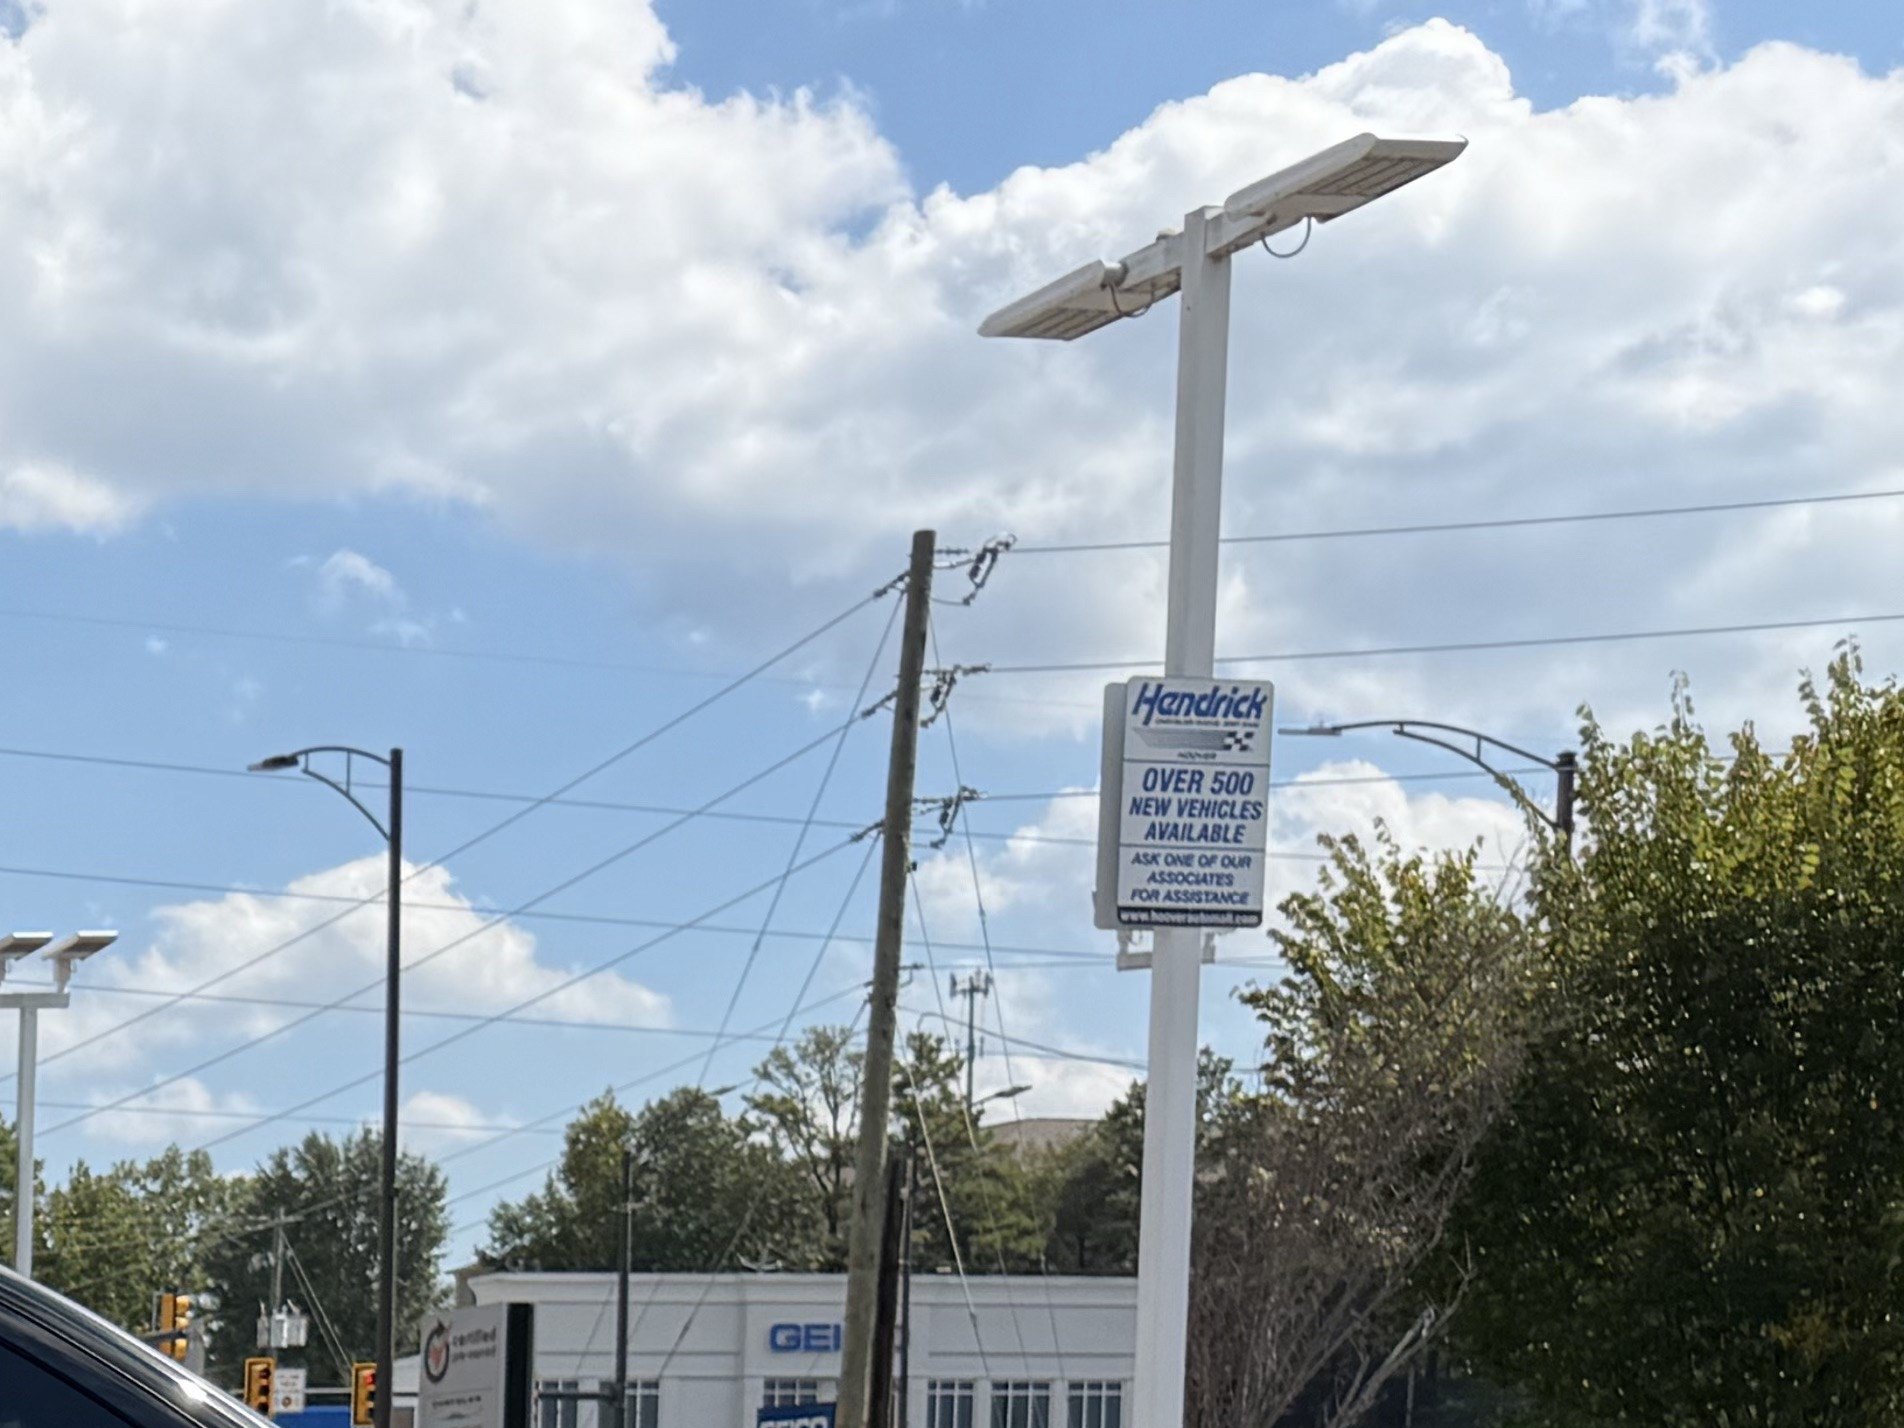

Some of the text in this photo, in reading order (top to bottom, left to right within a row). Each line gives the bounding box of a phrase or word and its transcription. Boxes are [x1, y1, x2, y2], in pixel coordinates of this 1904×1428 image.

[1132, 682, 1268, 726] Hendrick
[1142, 768, 1254, 795] OVER 500
[1129, 797, 1264, 820] NEW VEHICLES
[1145, 822, 1246, 843] AVAILABLE
[1131, 852, 1252, 869] ASK ONE OF OUR
[1147, 872, 1234, 886] ASSOCIATES
[1131, 890, 1250, 905] FOR ASSISTANCE
[770, 1324, 841, 1351] GEI
